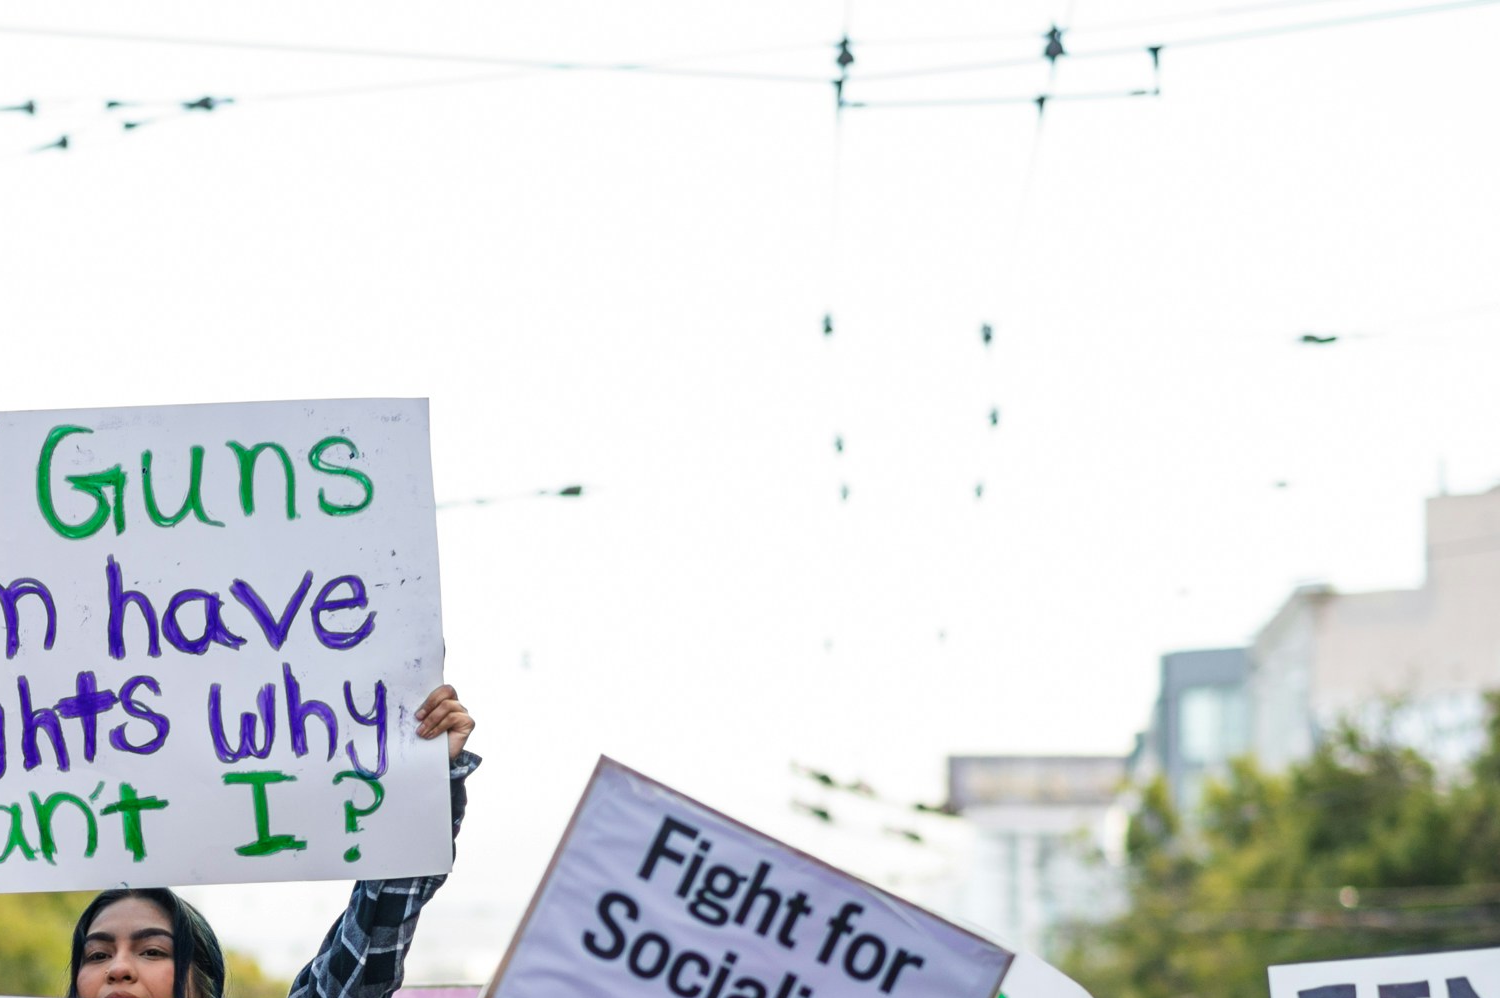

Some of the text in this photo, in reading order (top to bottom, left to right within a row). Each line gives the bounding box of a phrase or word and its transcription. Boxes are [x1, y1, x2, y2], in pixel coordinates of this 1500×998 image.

[35, 425, 374, 540] Guns
[105, 554, 377, 659] have
[207, 663, 389, 779] why
[637, 815, 925, 995] Fight for
